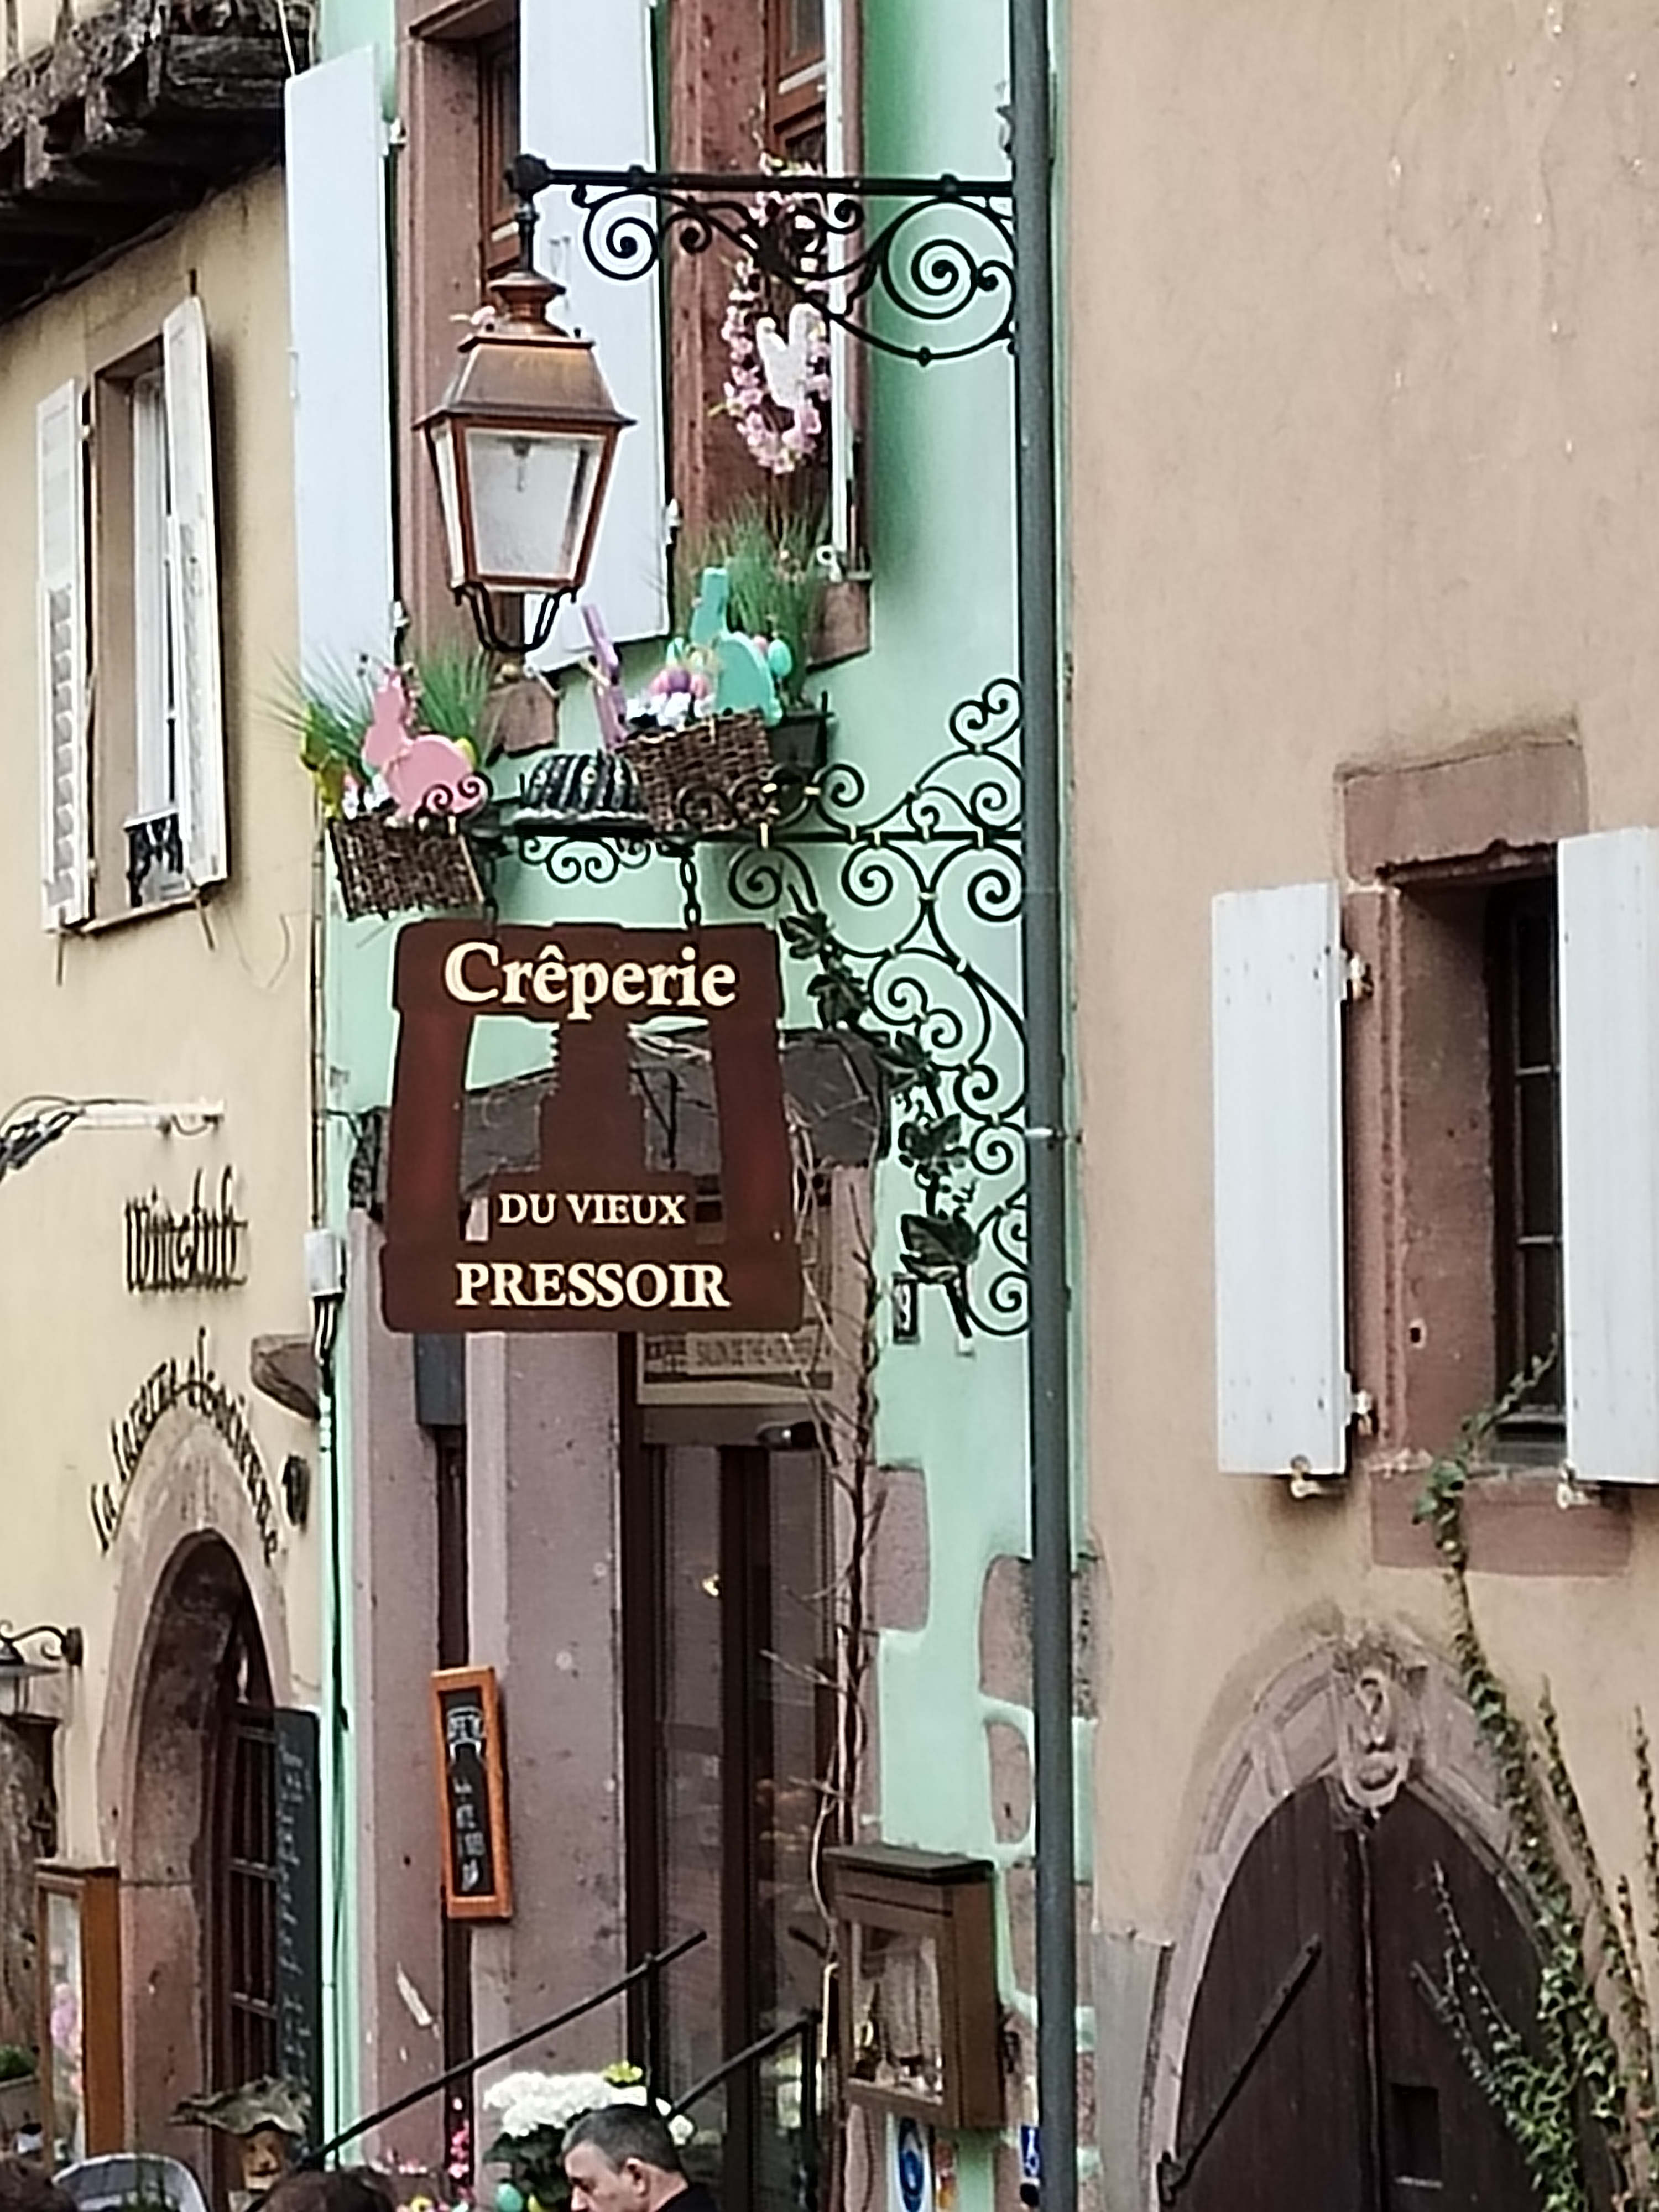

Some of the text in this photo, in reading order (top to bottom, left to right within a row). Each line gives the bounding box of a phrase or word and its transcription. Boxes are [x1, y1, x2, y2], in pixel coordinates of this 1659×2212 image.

[445, 942, 736, 1021] Crêperie
[499, 1193, 686, 1224] DU VIEUX
[456, 1262, 731, 1307] PRESSOIR
